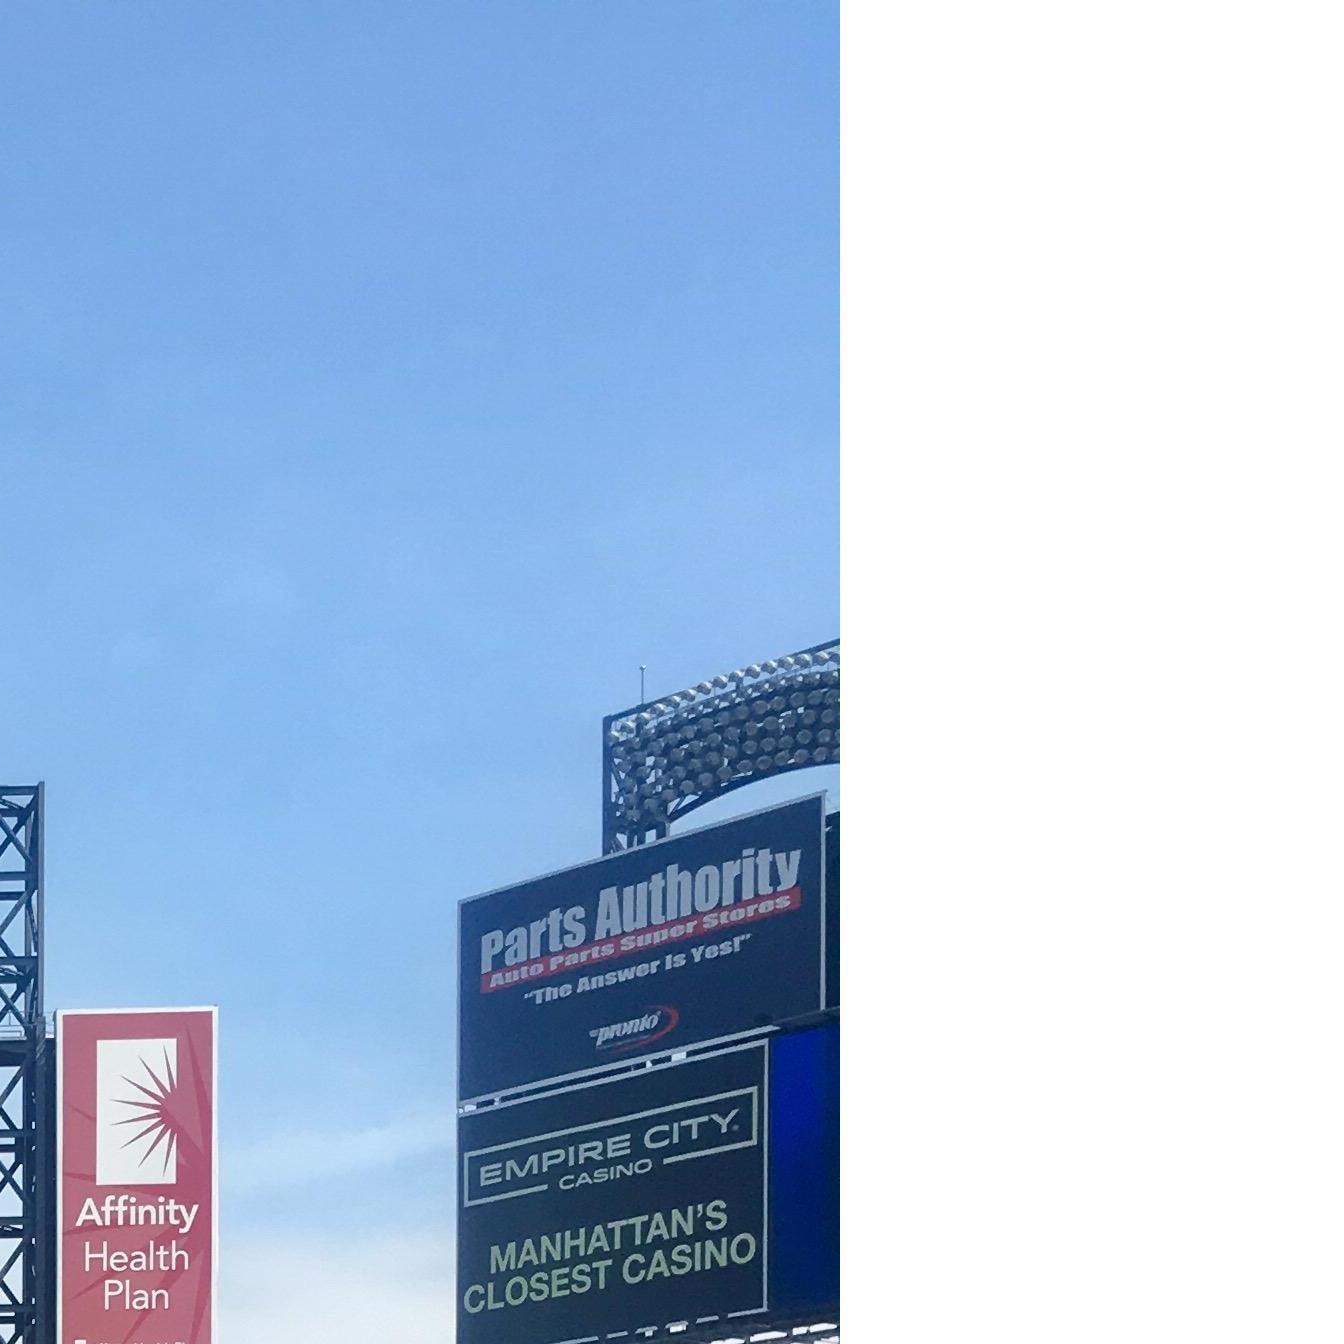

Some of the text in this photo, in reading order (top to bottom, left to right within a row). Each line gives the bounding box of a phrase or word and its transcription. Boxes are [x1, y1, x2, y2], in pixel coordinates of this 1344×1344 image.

[481, 847, 802, 975] Parts Authority
[489, 894, 791, 988] Auto Parts Super Stores
[576, 959, 660, 993] Answer
[665, 953, 686, 970] Is
[480, 1108, 739, 1187] EMPIRE CITY
[559, 1158, 653, 1190] CASINO
[75, 1194, 199, 1234] Affinity
[490, 1200, 728, 1274] MANHATTAN'S
[85, 1240, 189, 1272] Health
[463, 1232, 756, 1313] CLOSEST CASINO
[104, 1279, 169, 1310] Plan
